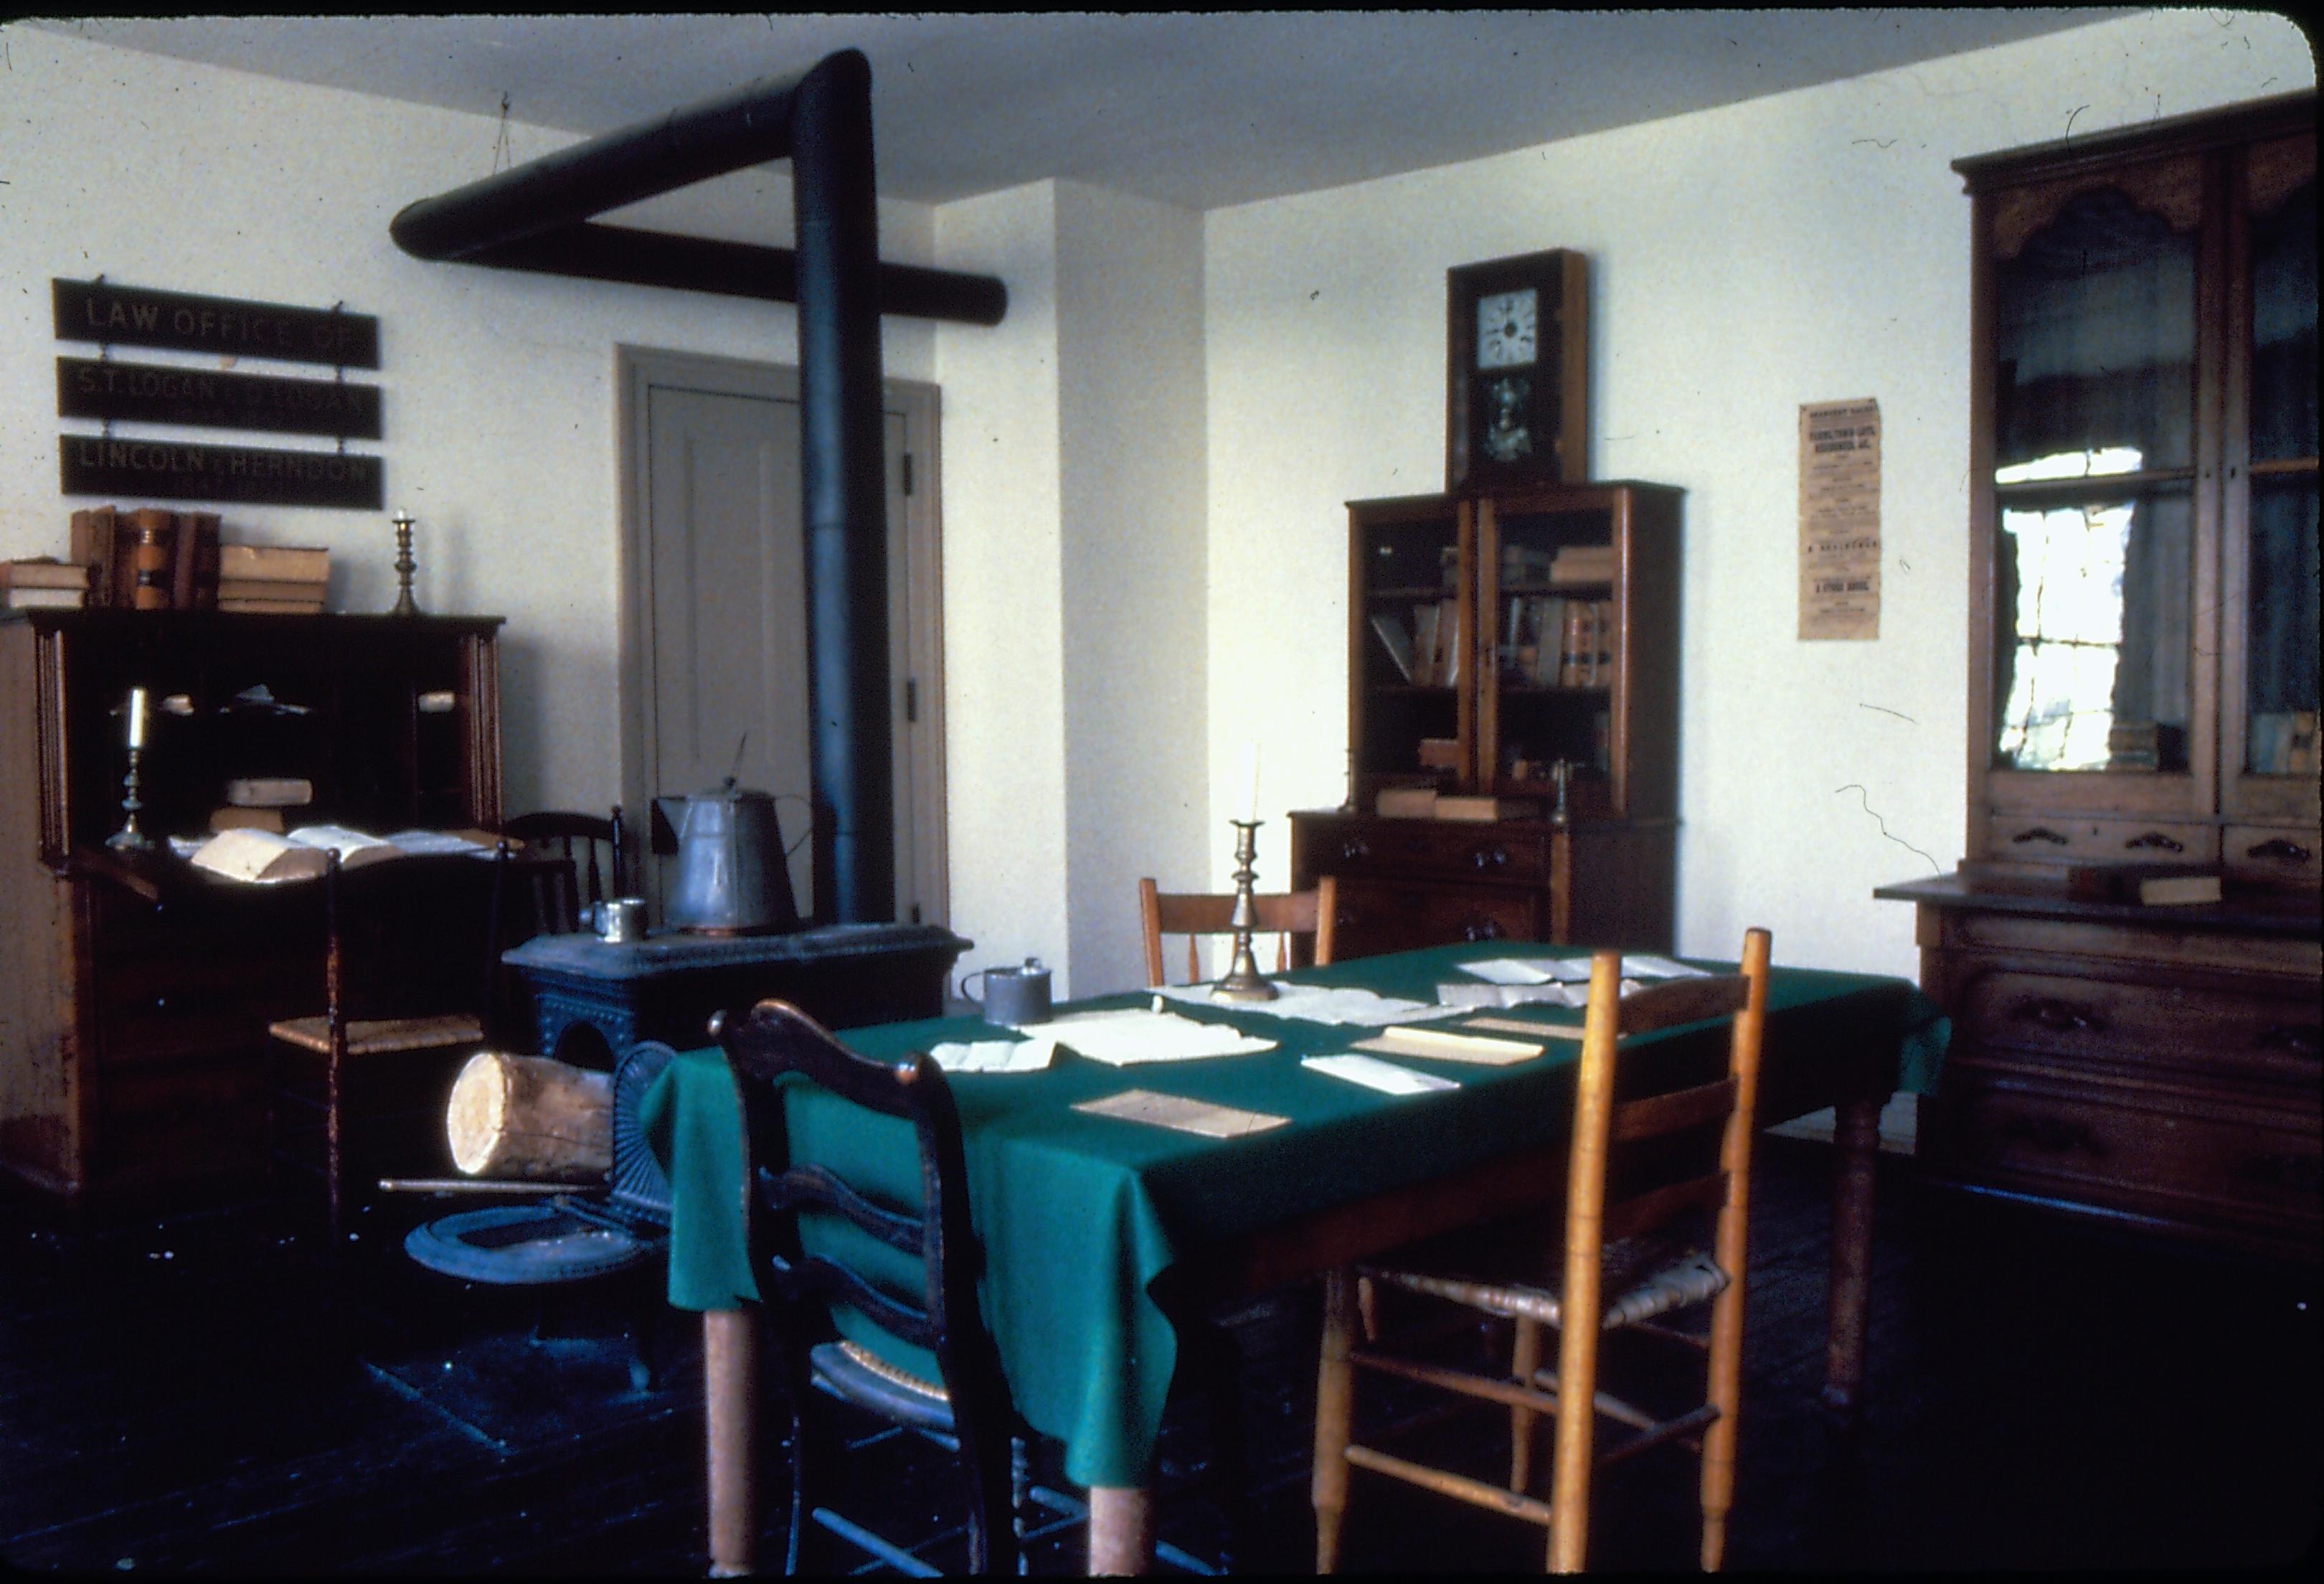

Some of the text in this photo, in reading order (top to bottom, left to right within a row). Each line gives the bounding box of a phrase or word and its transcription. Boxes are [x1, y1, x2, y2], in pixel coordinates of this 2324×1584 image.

[85, 297, 353, 349] LAW OFFICE OF
[79, 440, 204, 472] LINCOLN
[231, 452, 367, 482] HERNDON
